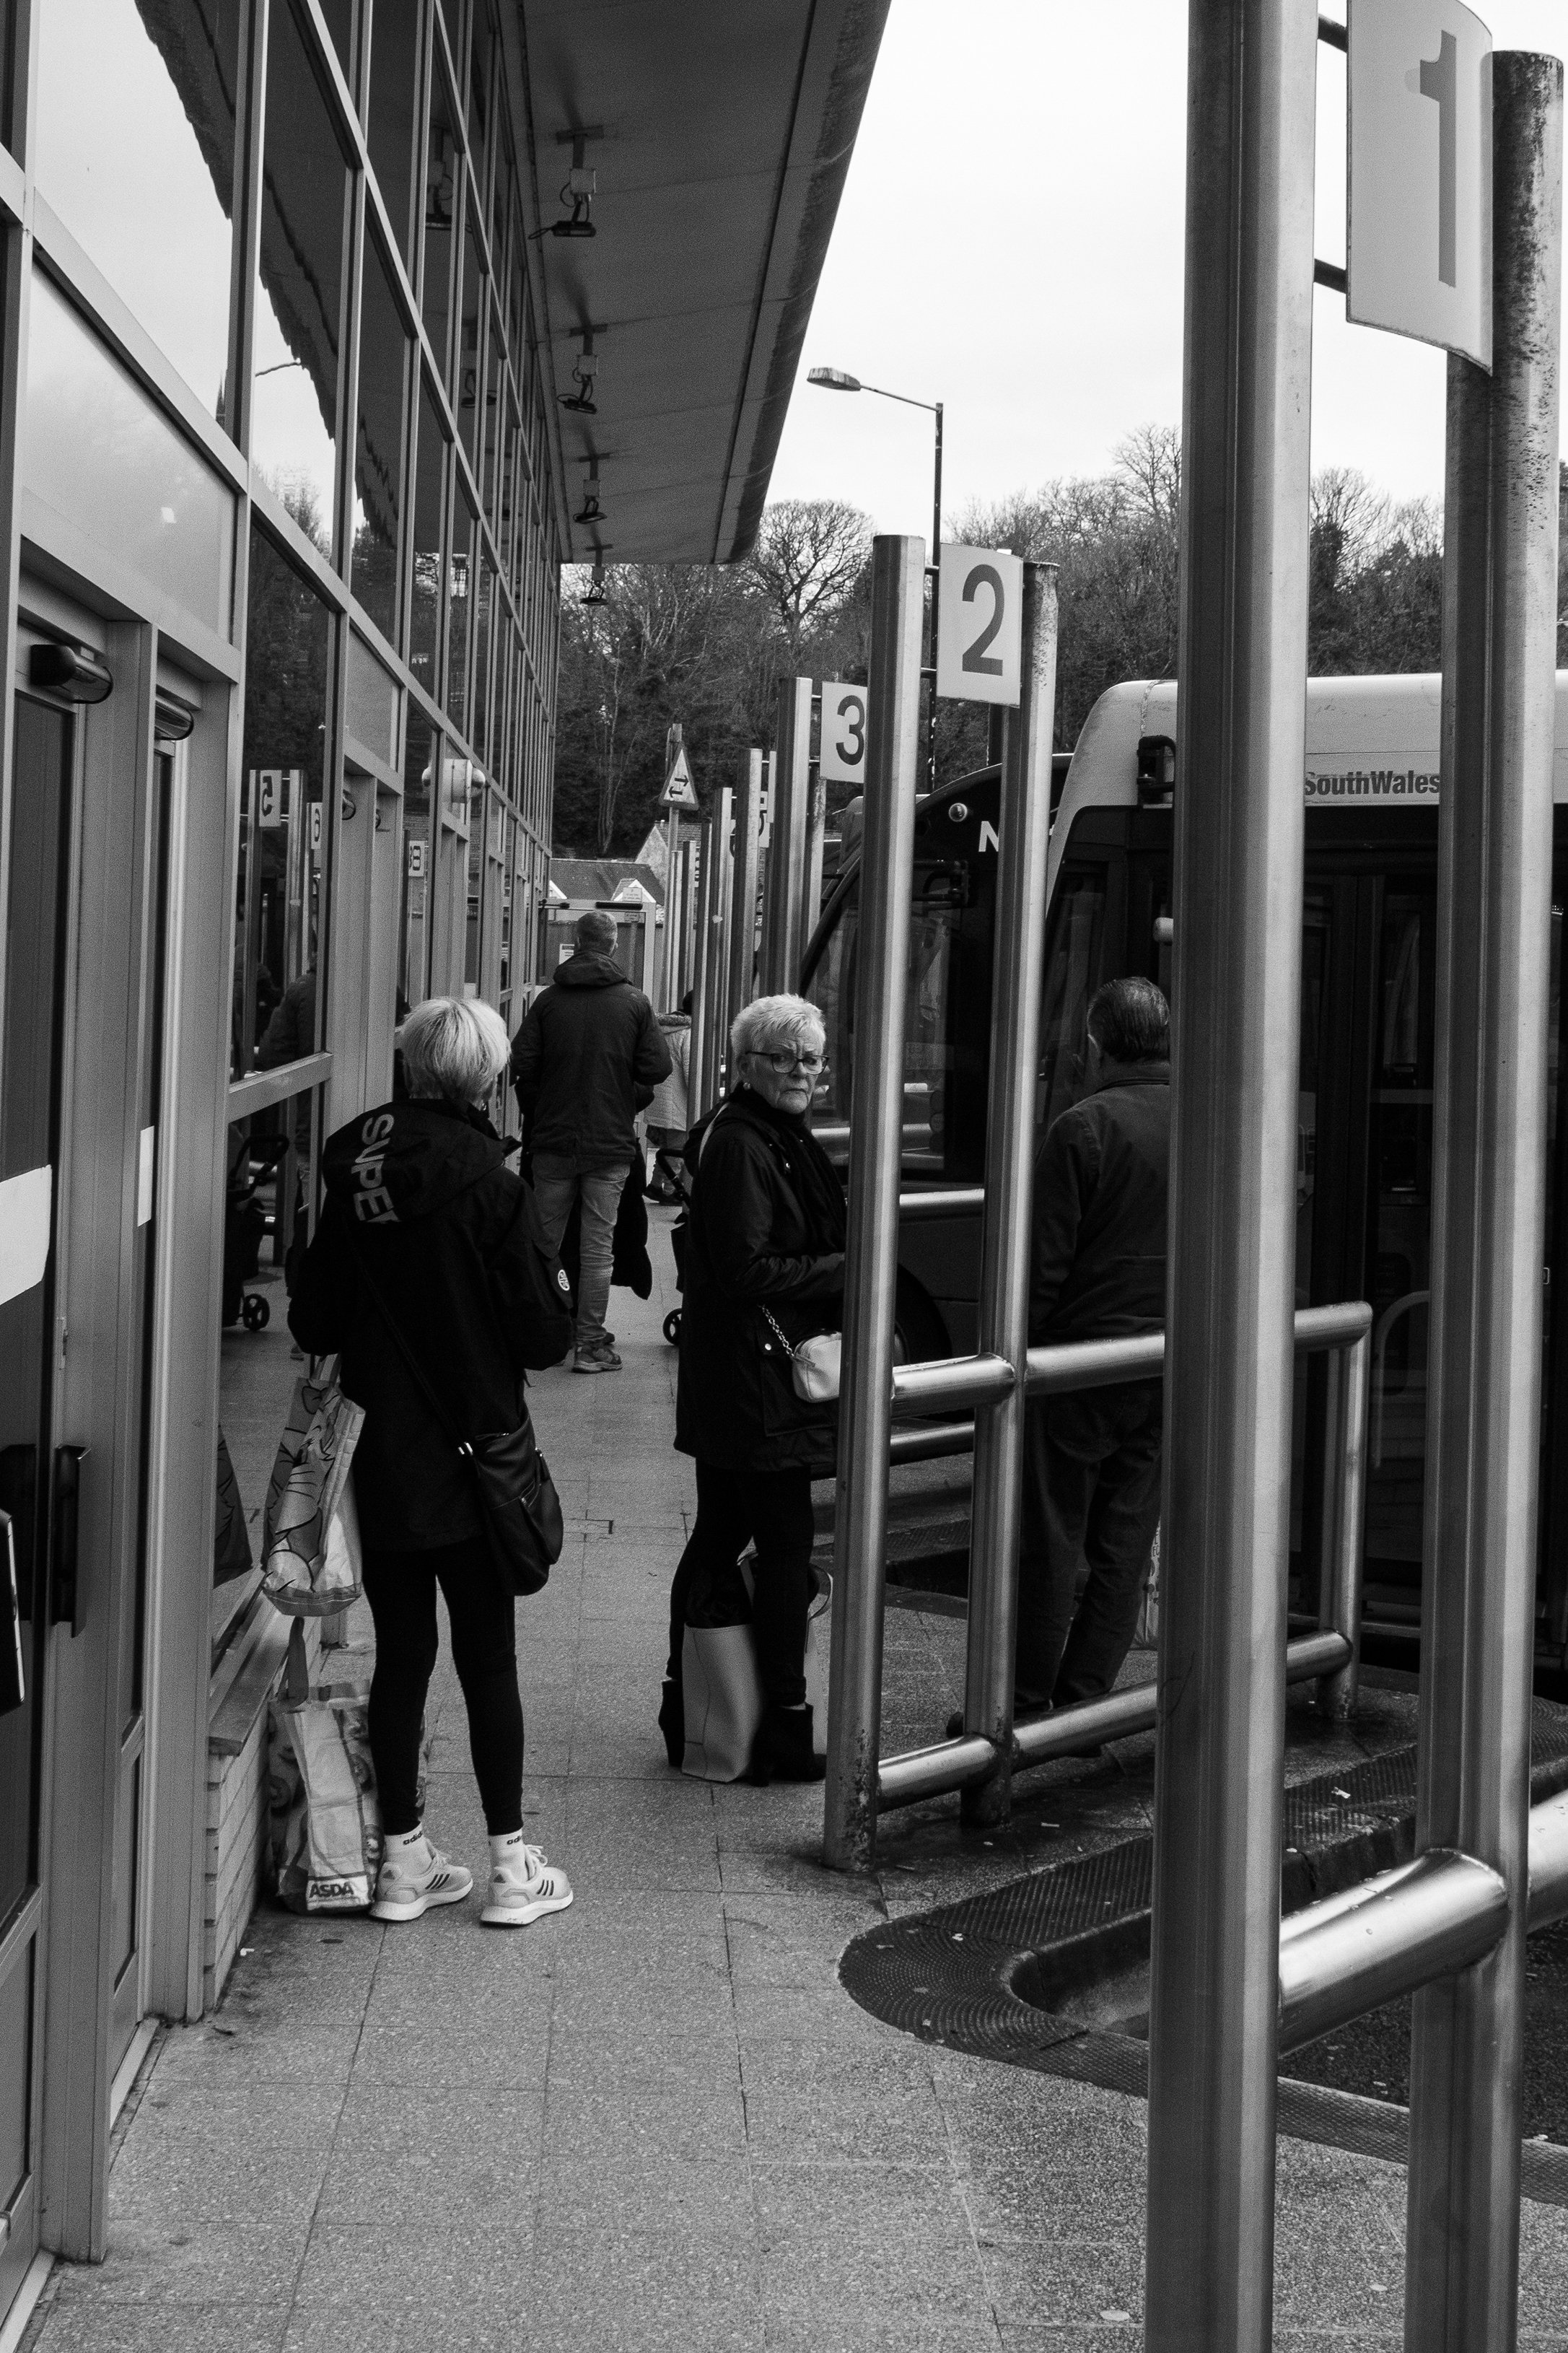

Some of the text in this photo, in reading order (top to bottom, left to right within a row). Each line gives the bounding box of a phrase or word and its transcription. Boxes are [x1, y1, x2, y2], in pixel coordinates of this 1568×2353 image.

[1420, 30, 1456, 288] 1
[962, 564, 1005, 676] 2
[836, 695, 864, 765] 3
[309, 1881, 354, 1898] ASDA
